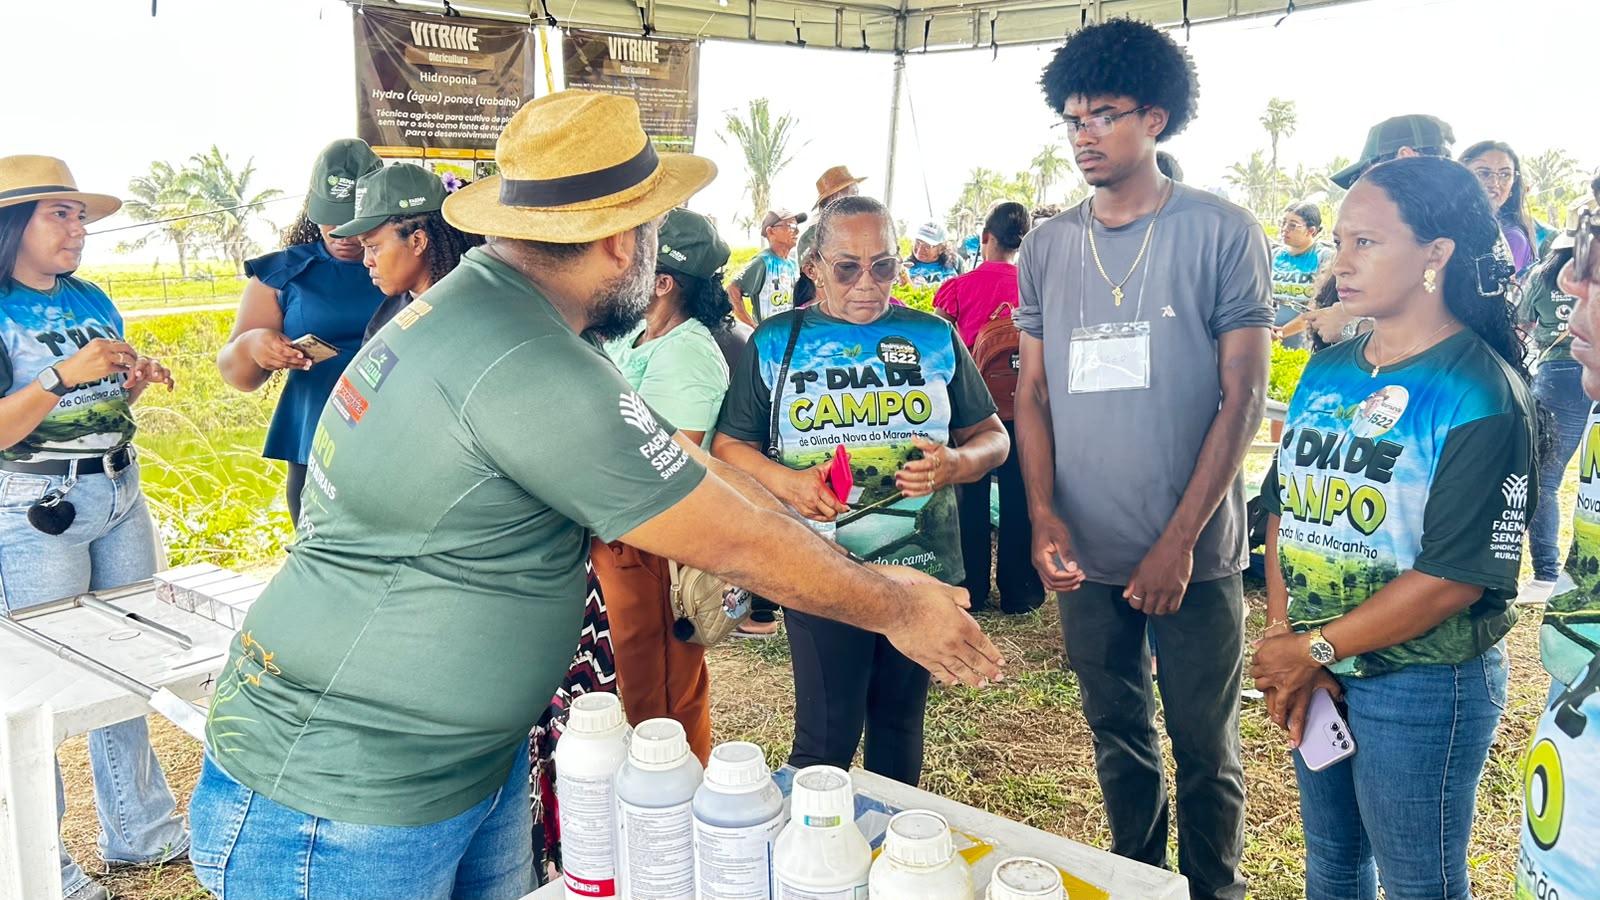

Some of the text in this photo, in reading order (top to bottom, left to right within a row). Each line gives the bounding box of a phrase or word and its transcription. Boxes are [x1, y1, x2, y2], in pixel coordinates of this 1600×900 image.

[410, 21, 480, 51] VITRINE
[608, 36, 660, 64] VITRINE
[428, 52, 469, 65] Olericultura
[419, 71, 477, 86] Hidroponia
[372, 88, 520, 109] Hydro (água) ponos (trabalho)
[376, 109, 409, 119] Técnica
[444, 113, 464, 123] para
[464, 115, 491, 123] cultivo
[491, 115, 501, 123] de
[378, 119, 395, 127] sem
[396, 119, 410, 128] ter
[417, 120, 435, 129] solo
[436, 122, 458, 130] como
[458, 121, 479, 131] fonte
[479, 123, 490, 131] de
[405, 129, 499, 140] para o desenvolvimento
[882, 351, 917, 365] 1522
[826, 365, 883, 390] DIA
[885, 365, 926, 387] DE
[59, 399, 73, 409] de
[789, 389, 932, 432] CAMPO
[1367, 412, 1394, 429] 1522
[799, 437, 809, 447] de
[810, 433, 841, 446] Olinda
[843, 431, 867, 443] Nova
[868, 431, 881, 441] do
[1343, 437, 1405, 484] DE
[1502, 510, 1524, 521] CNA
[1307, 531, 1321, 546] do
[1322, 534, 1378, 560] Maranhão
[902, 551, 936, 566] campo,
